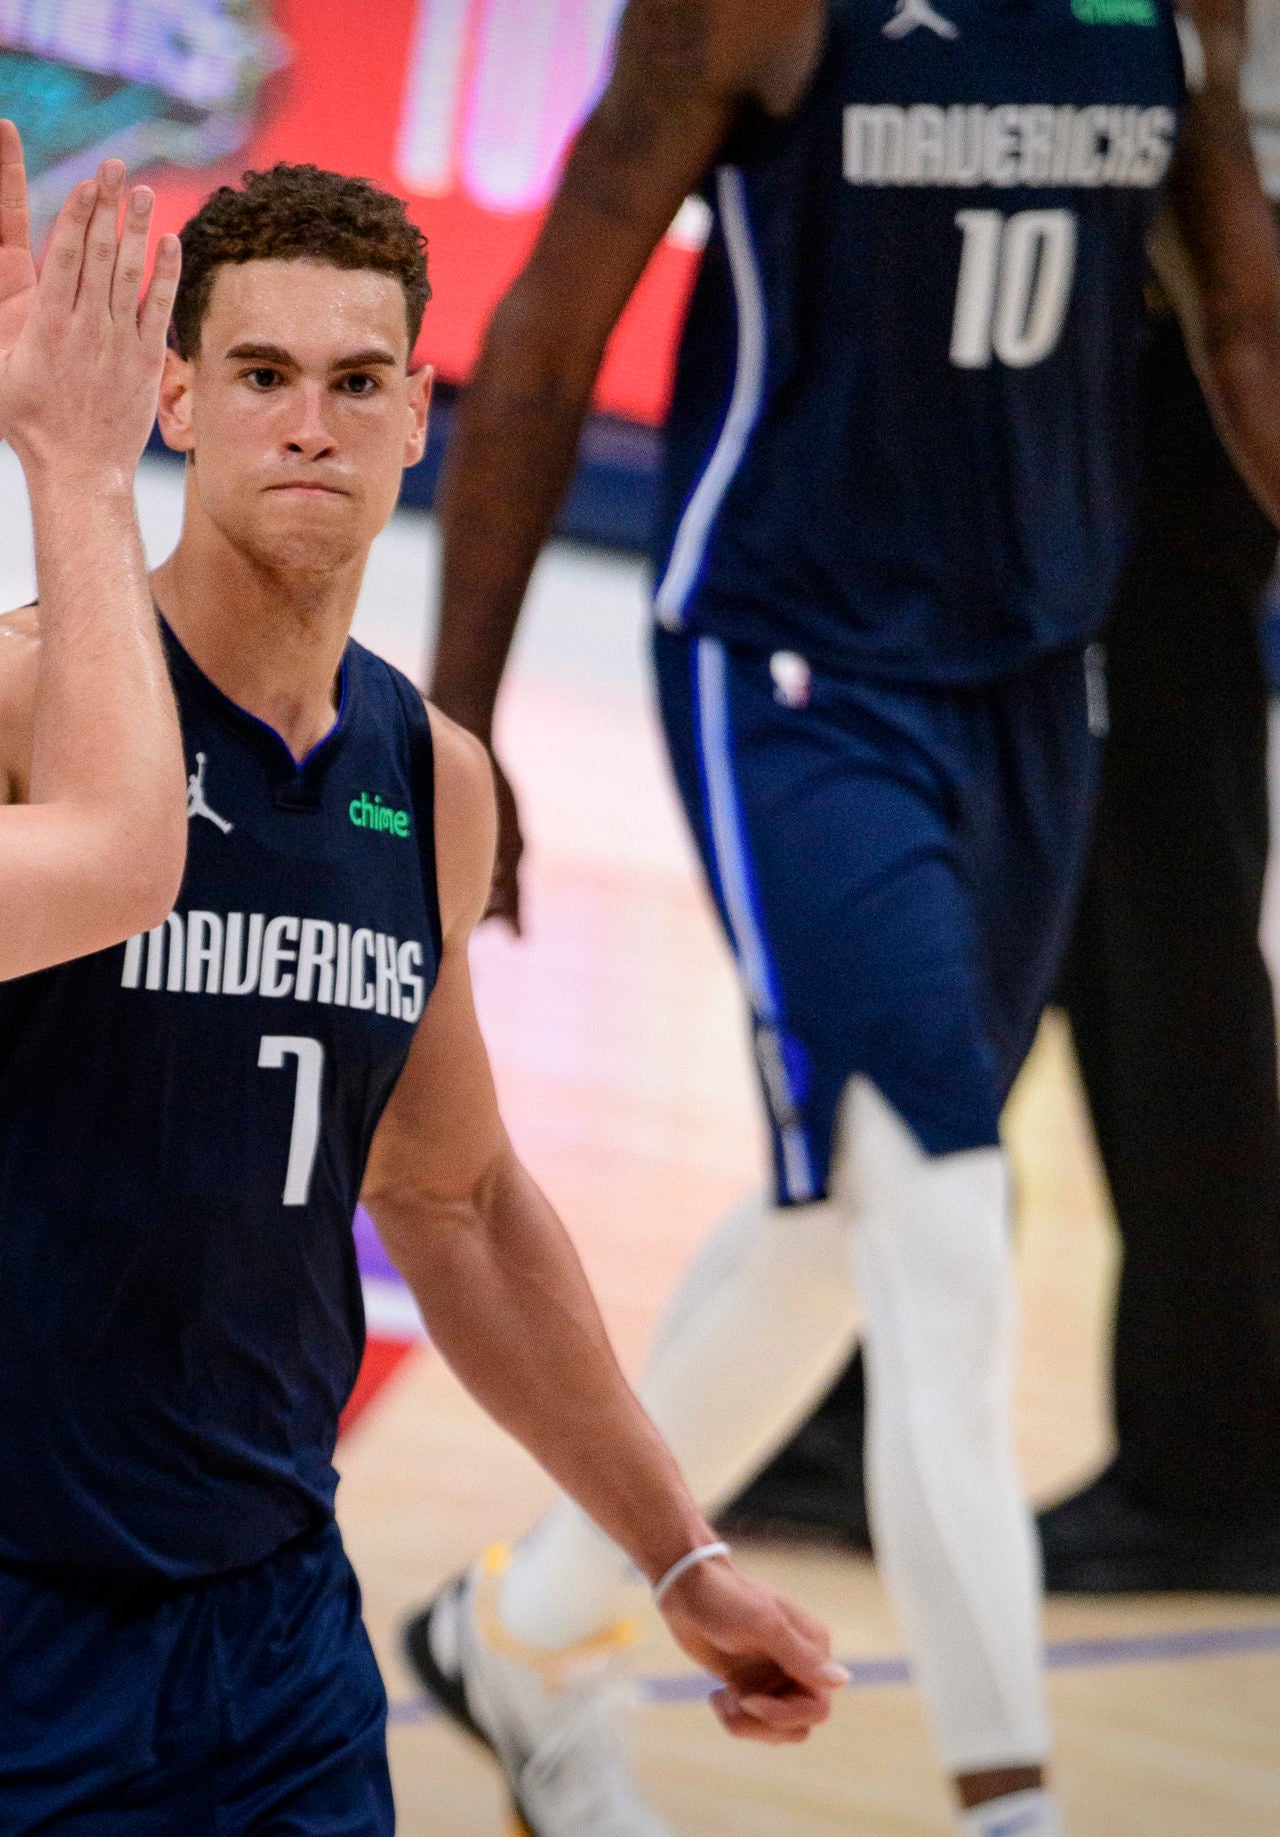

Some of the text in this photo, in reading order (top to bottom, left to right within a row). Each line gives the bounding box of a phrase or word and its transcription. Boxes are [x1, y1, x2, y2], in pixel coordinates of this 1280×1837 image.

[842, 103, 1176, 188] MAVERICKS
[949, 208, 1078, 369] 10
[348, 791, 410, 838] chime
[121, 910, 424, 1024] MAVERICKS
[258, 1035, 324, 1206] 7
